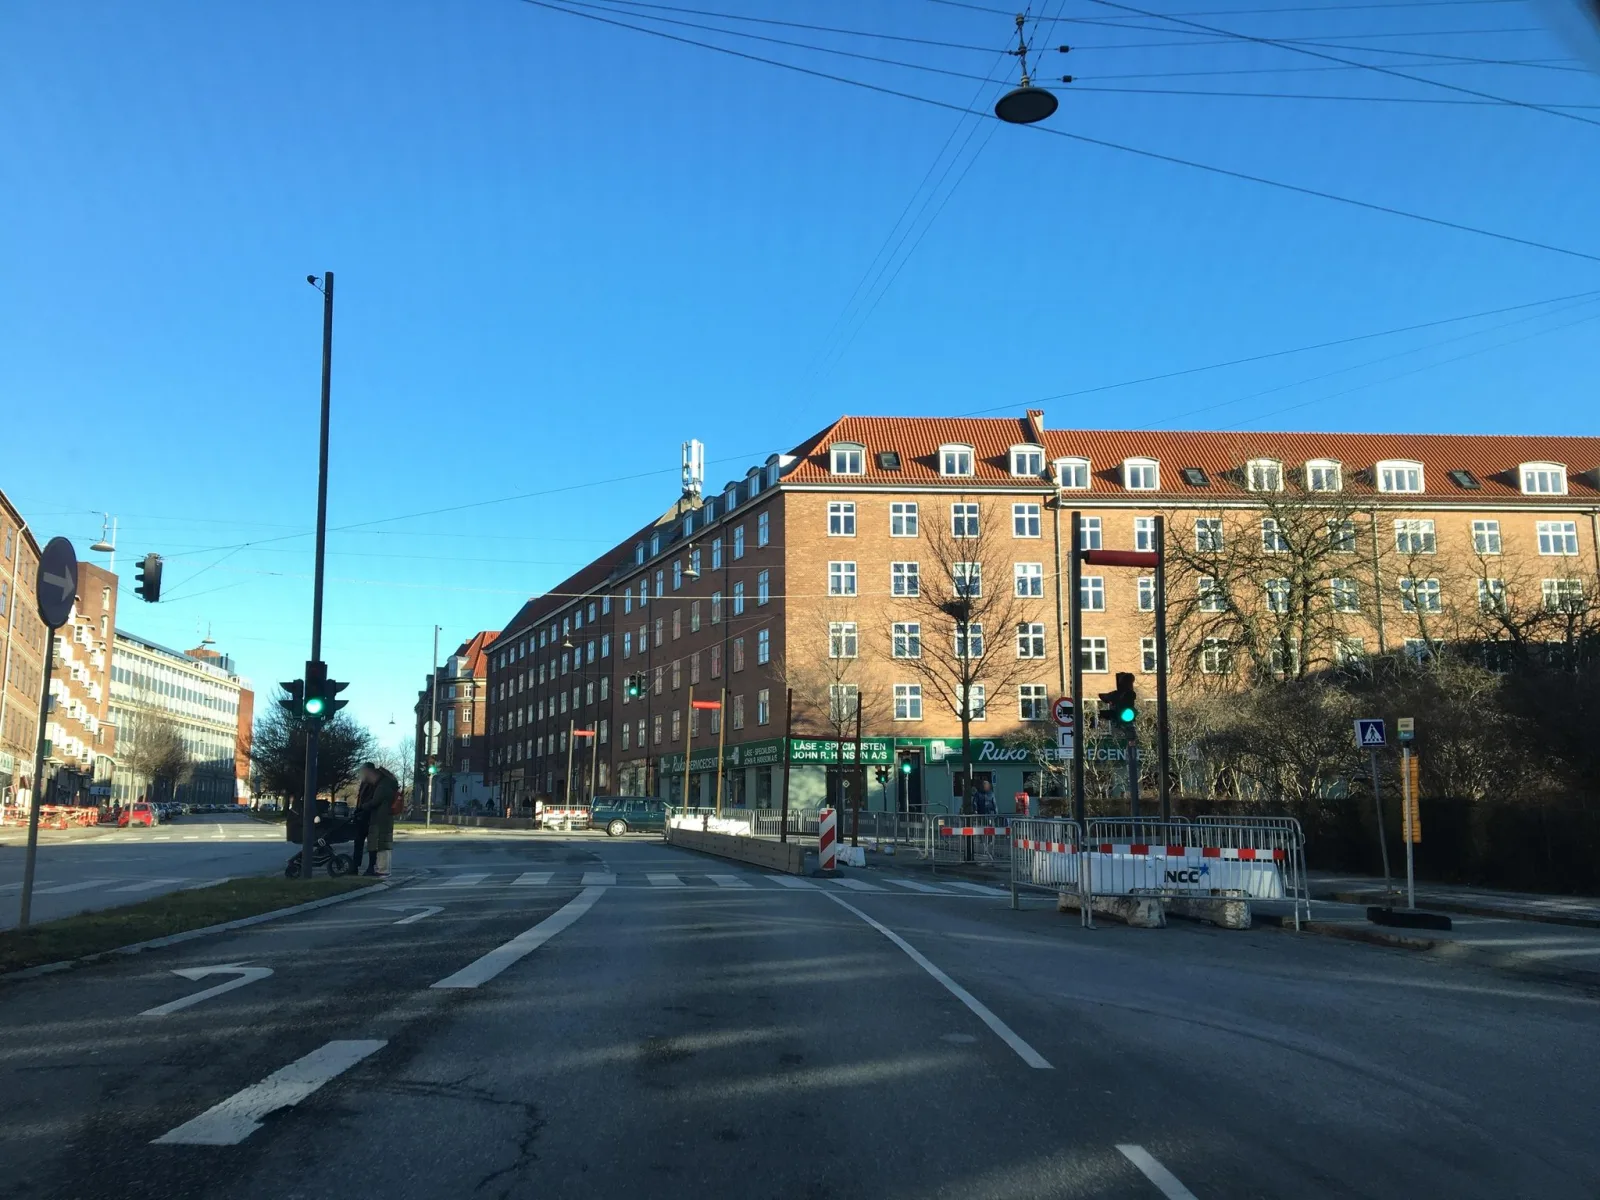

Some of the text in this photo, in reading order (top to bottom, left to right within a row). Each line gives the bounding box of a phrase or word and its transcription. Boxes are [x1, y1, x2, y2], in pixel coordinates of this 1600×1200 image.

[794, 741, 817, 751] LÅSE
[825, 742, 886, 751] SPCIAISTEN
[793, 751, 888, 759] JOHN R. HNSN A/S
[1164, 870, 1199, 883] NCC
